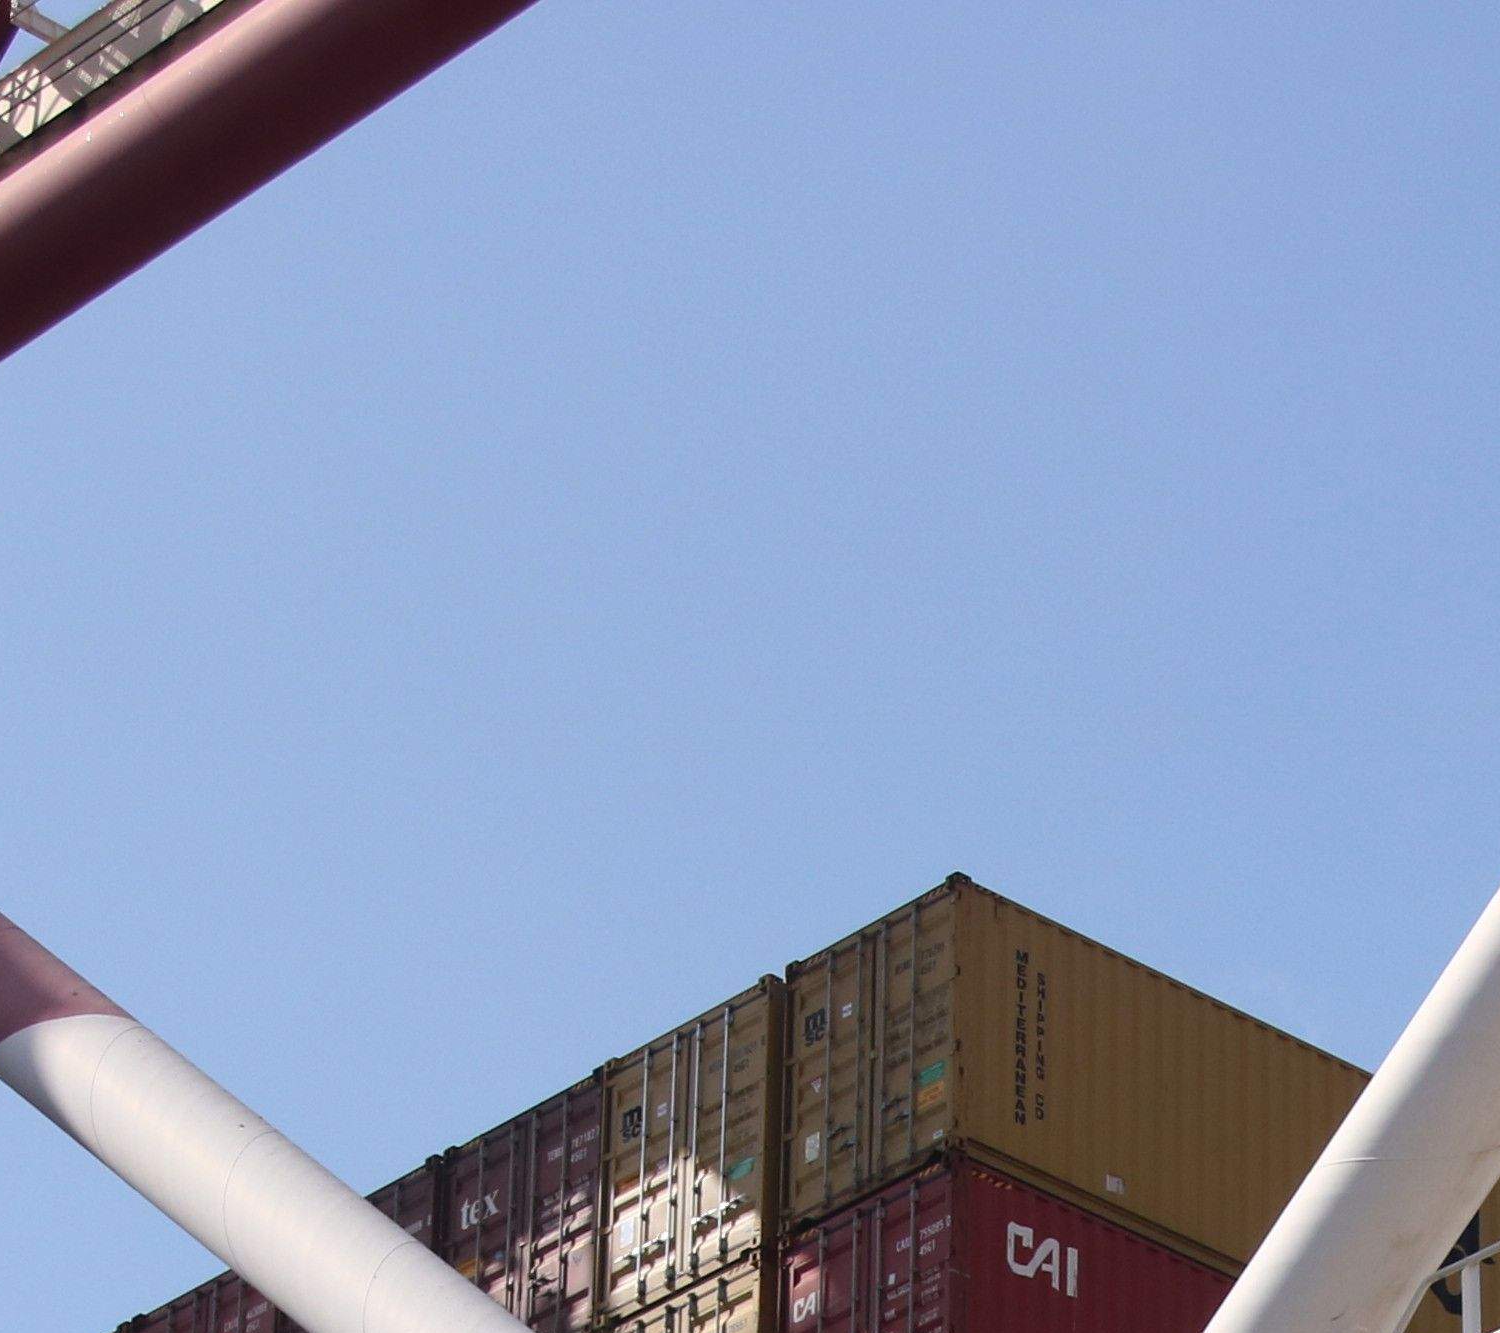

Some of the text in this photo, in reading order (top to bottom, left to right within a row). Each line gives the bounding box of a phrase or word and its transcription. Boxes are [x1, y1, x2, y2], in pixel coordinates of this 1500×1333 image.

[1015, 949, 1029, 1126] MEDITERRANEAN
[1035, 972, 1045, 1081] SHIPPING
[460, 1188, 499, 1231] tex
[1006, 1220, 1080, 1298] CAI
